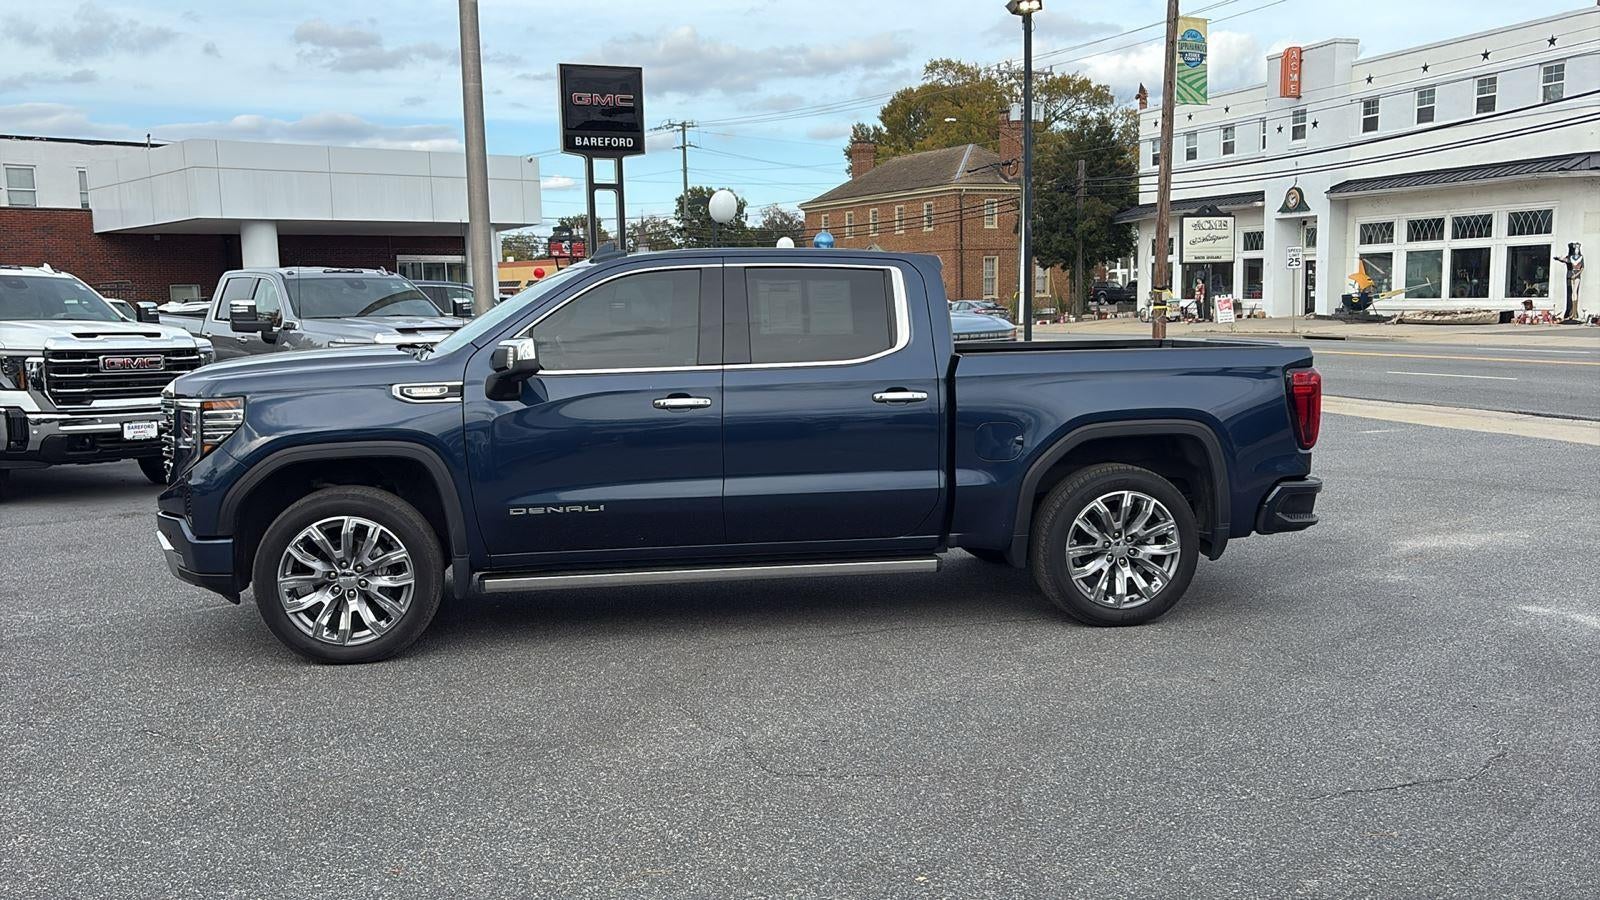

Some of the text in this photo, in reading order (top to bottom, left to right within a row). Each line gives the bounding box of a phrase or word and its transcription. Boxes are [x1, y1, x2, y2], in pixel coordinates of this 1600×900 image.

[1289, 50, 1298, 93] ACME
[572, 92, 634, 107] GMC
[575, 136, 634, 147] BAREFORD
[1288, 257, 1301, 266] 25
[105, 357, 162, 369] GMC
[127, 423, 154, 431] BAREFORD
[509, 505, 604, 515] DENALI
